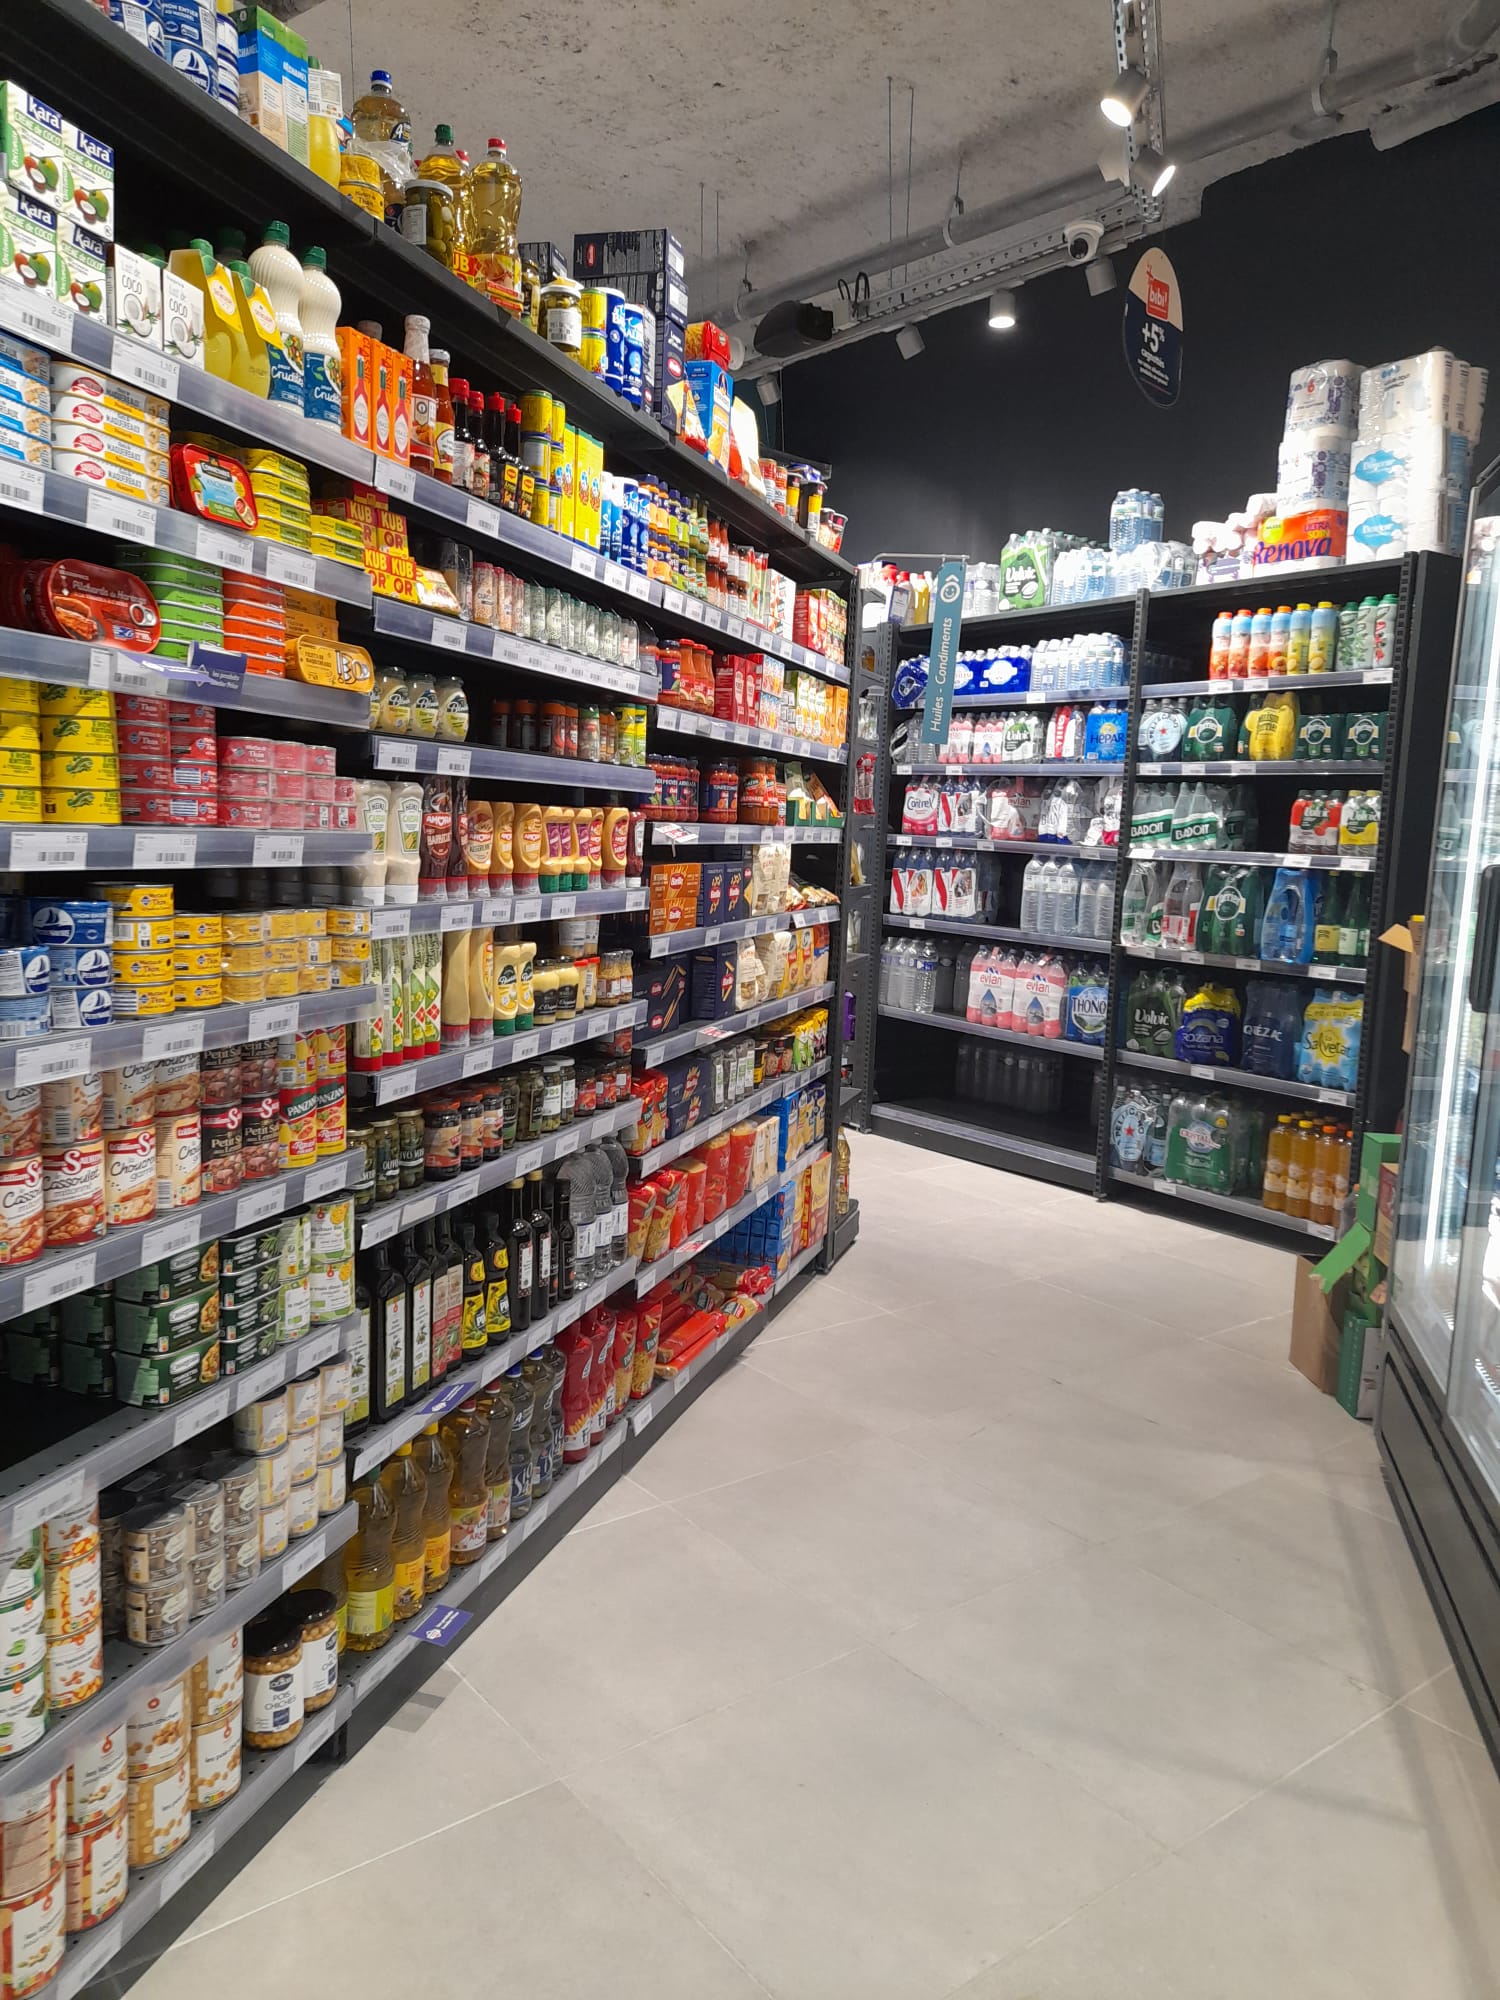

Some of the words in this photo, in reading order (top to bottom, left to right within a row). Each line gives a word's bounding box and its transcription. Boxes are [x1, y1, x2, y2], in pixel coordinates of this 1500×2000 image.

[350, 501, 373, 523] KUB
[382, 511, 404, 532] KUB
[384, 531, 404, 550] OR
[365, 550, 386, 571] KUB
[1254, 537, 1331, 565] Renova
[391, 556, 414, 577] KUB
[393, 574, 412, 594] OR
[934, 616, 953, 685] Condiments
[930, 696, 944, 733] Huiles
[1131, 822, 1164, 837] BADOIT
[1175, 823, 1209, 840] BADOIT
[980, 975, 1002, 986] evian
[1026, 982, 1050, 993] evian
[1072, 996, 1107, 1015] THONO
[1135, 1008, 1169, 1026] Volvic
[1243, 1024, 1282, 1042] QUÉZAC
